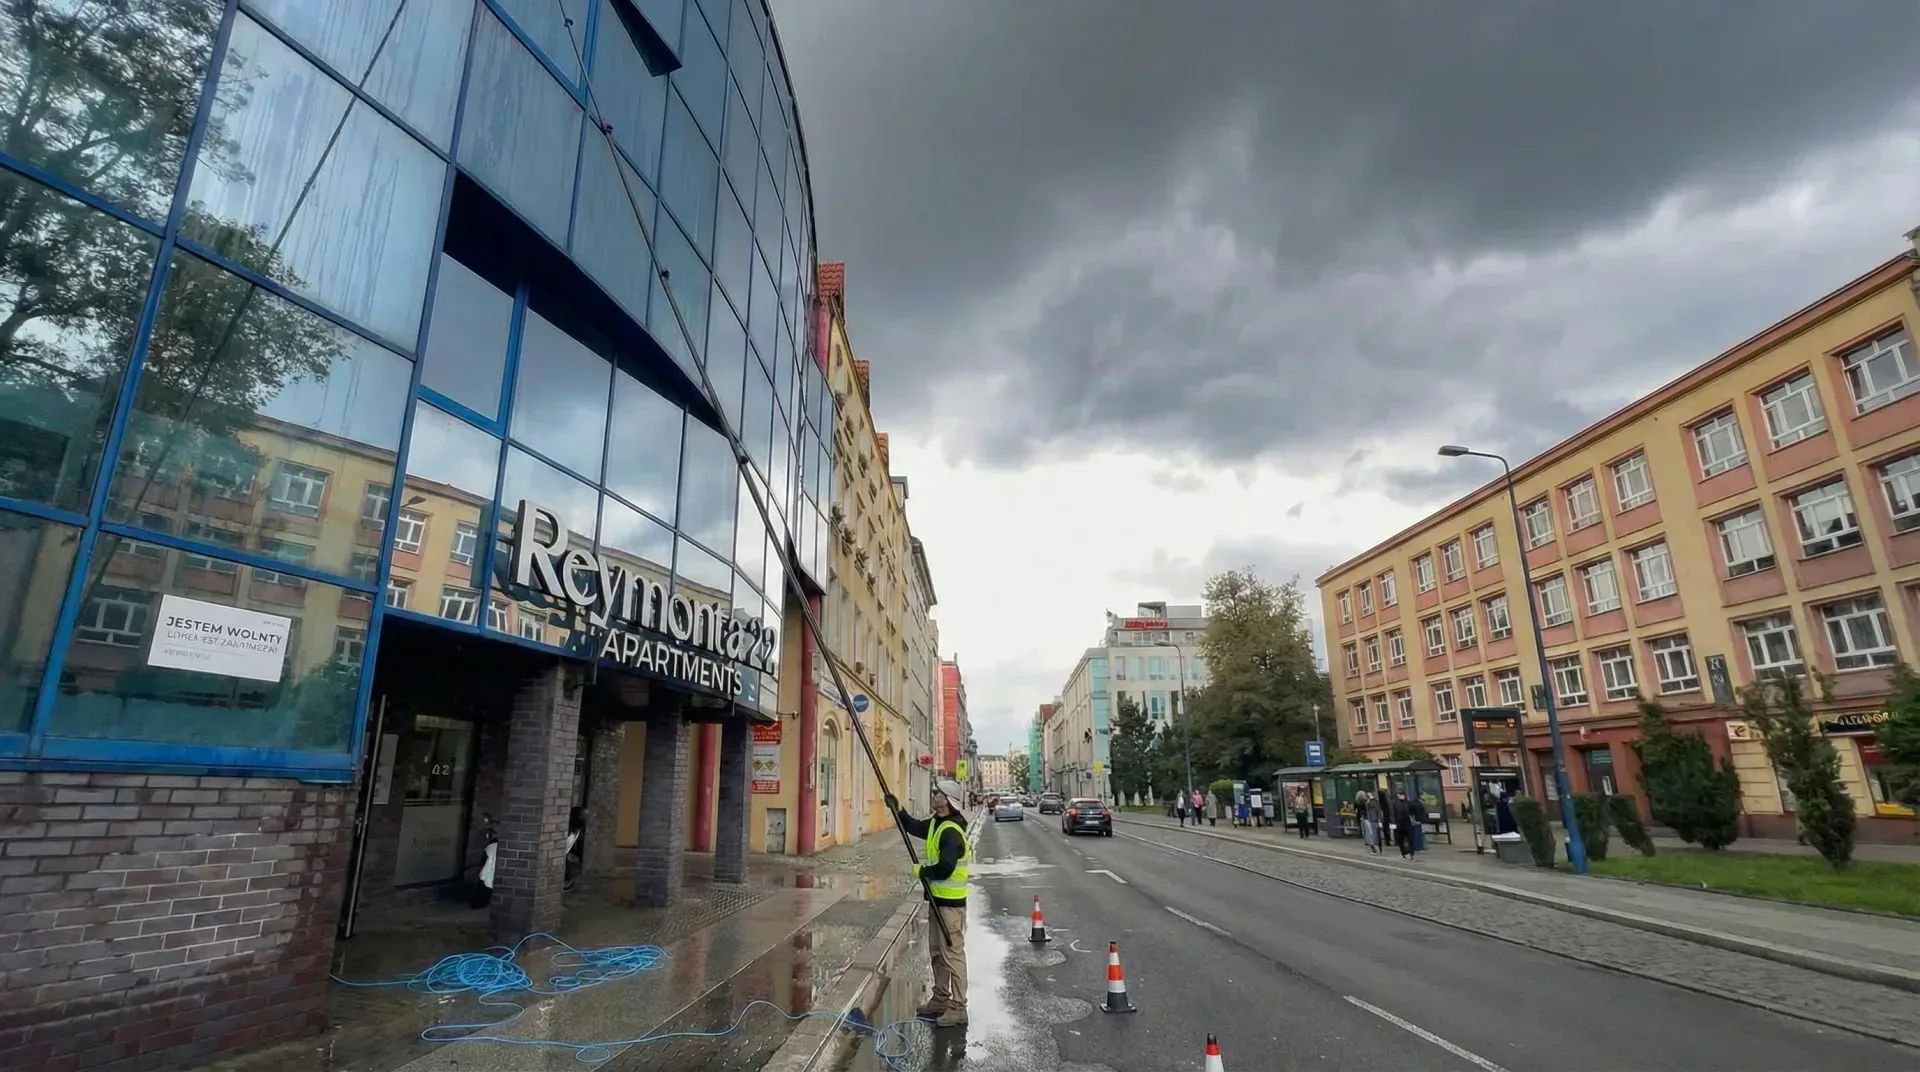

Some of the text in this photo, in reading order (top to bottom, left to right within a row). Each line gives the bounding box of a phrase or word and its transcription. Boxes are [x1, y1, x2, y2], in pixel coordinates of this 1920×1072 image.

[166, 616, 283, 645] JESTEM WOLNTY
[600, 629, 743, 696] APARTMENTS
